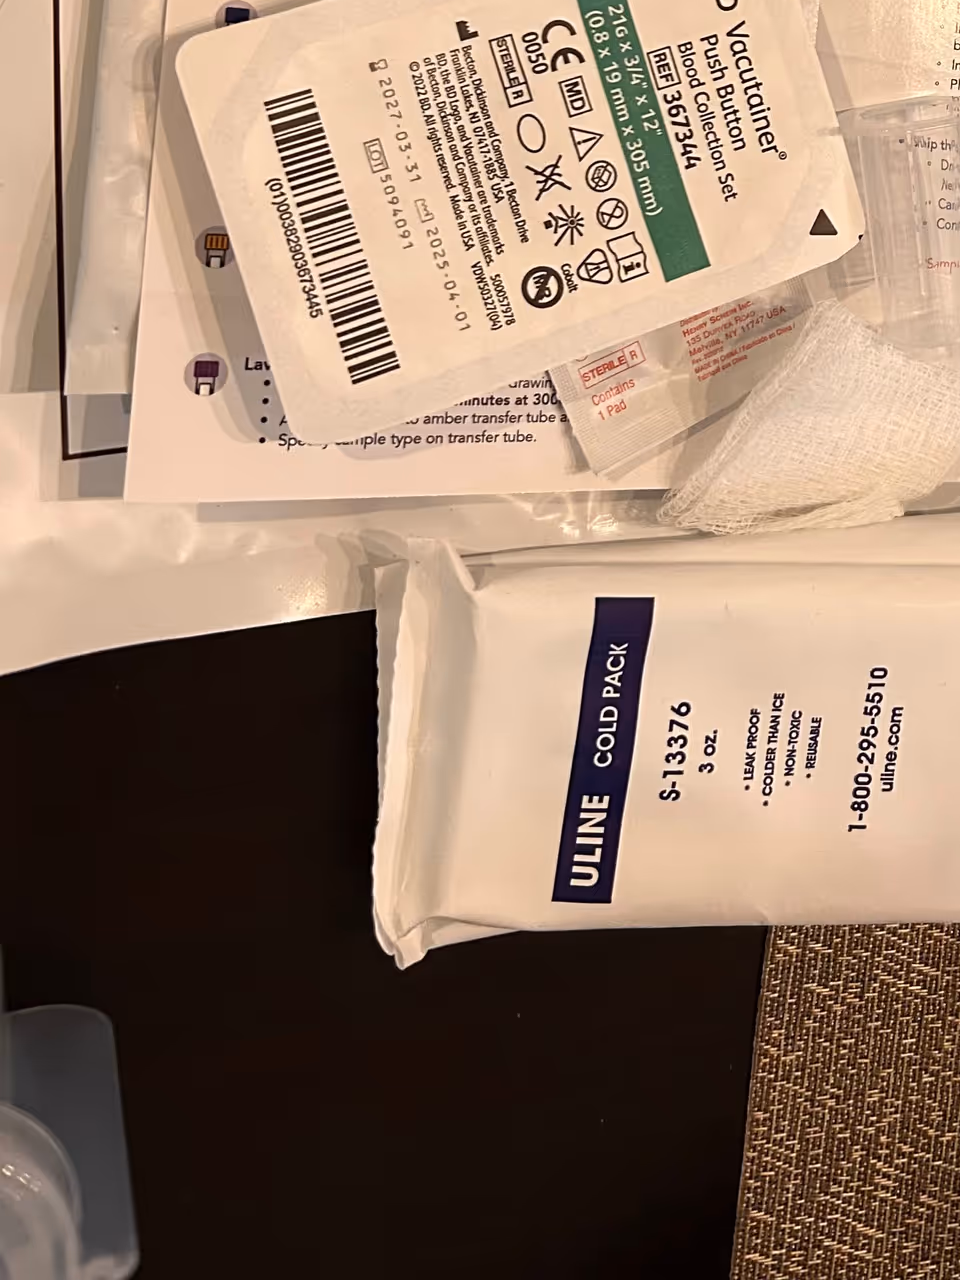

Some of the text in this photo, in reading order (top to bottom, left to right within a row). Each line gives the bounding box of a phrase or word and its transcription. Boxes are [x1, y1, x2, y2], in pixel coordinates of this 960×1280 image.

[497, 38, 521, 87] STERILE
[520, 30, 549, 75] 0050
[450, 49, 505, 204] Franklin 07417-1885 USA
[583, 9, 663, 216] (0.8 mm 305 mm)
[652, 51, 702, 170] REF 367344
[676, 40, 738, 202] Blood Collection Set
[698, 33, 746, 151] Push Button
[472, 78, 522, 222] Dickinson Becton
[263, 177, 324, 319] (01)00382903673445
[379, 173, 414, 250] 5094091
[481, 204, 505, 255] trademarks
[448, 193, 503, 331] Made USA VDW50327(04)
[488, 273, 516, 326] 500057978
[559, 262, 578, 293] Cobalt
[765, 304, 787, 320] USA
[582, 355, 628, 383] STERILE
[592, 378, 635, 406] Contains
[597, 398, 627, 421] 1 Pad
[569, 642, 628, 887] ULINE COLD PACK
[657, 701, 691, 802] S-13376
[697, 728, 718, 774] 3 oz.
[742, 707, 761, 781] LEAK PROOF
[761, 692, 785, 796] COLDER THAN ICE
[782, 709, 803, 777] NON-TOXIC
[804, 716, 822, 769] REUSABLE
[846, 666, 888, 832] 1-800-295-5510
[879, 706, 904, 792] uline.com
